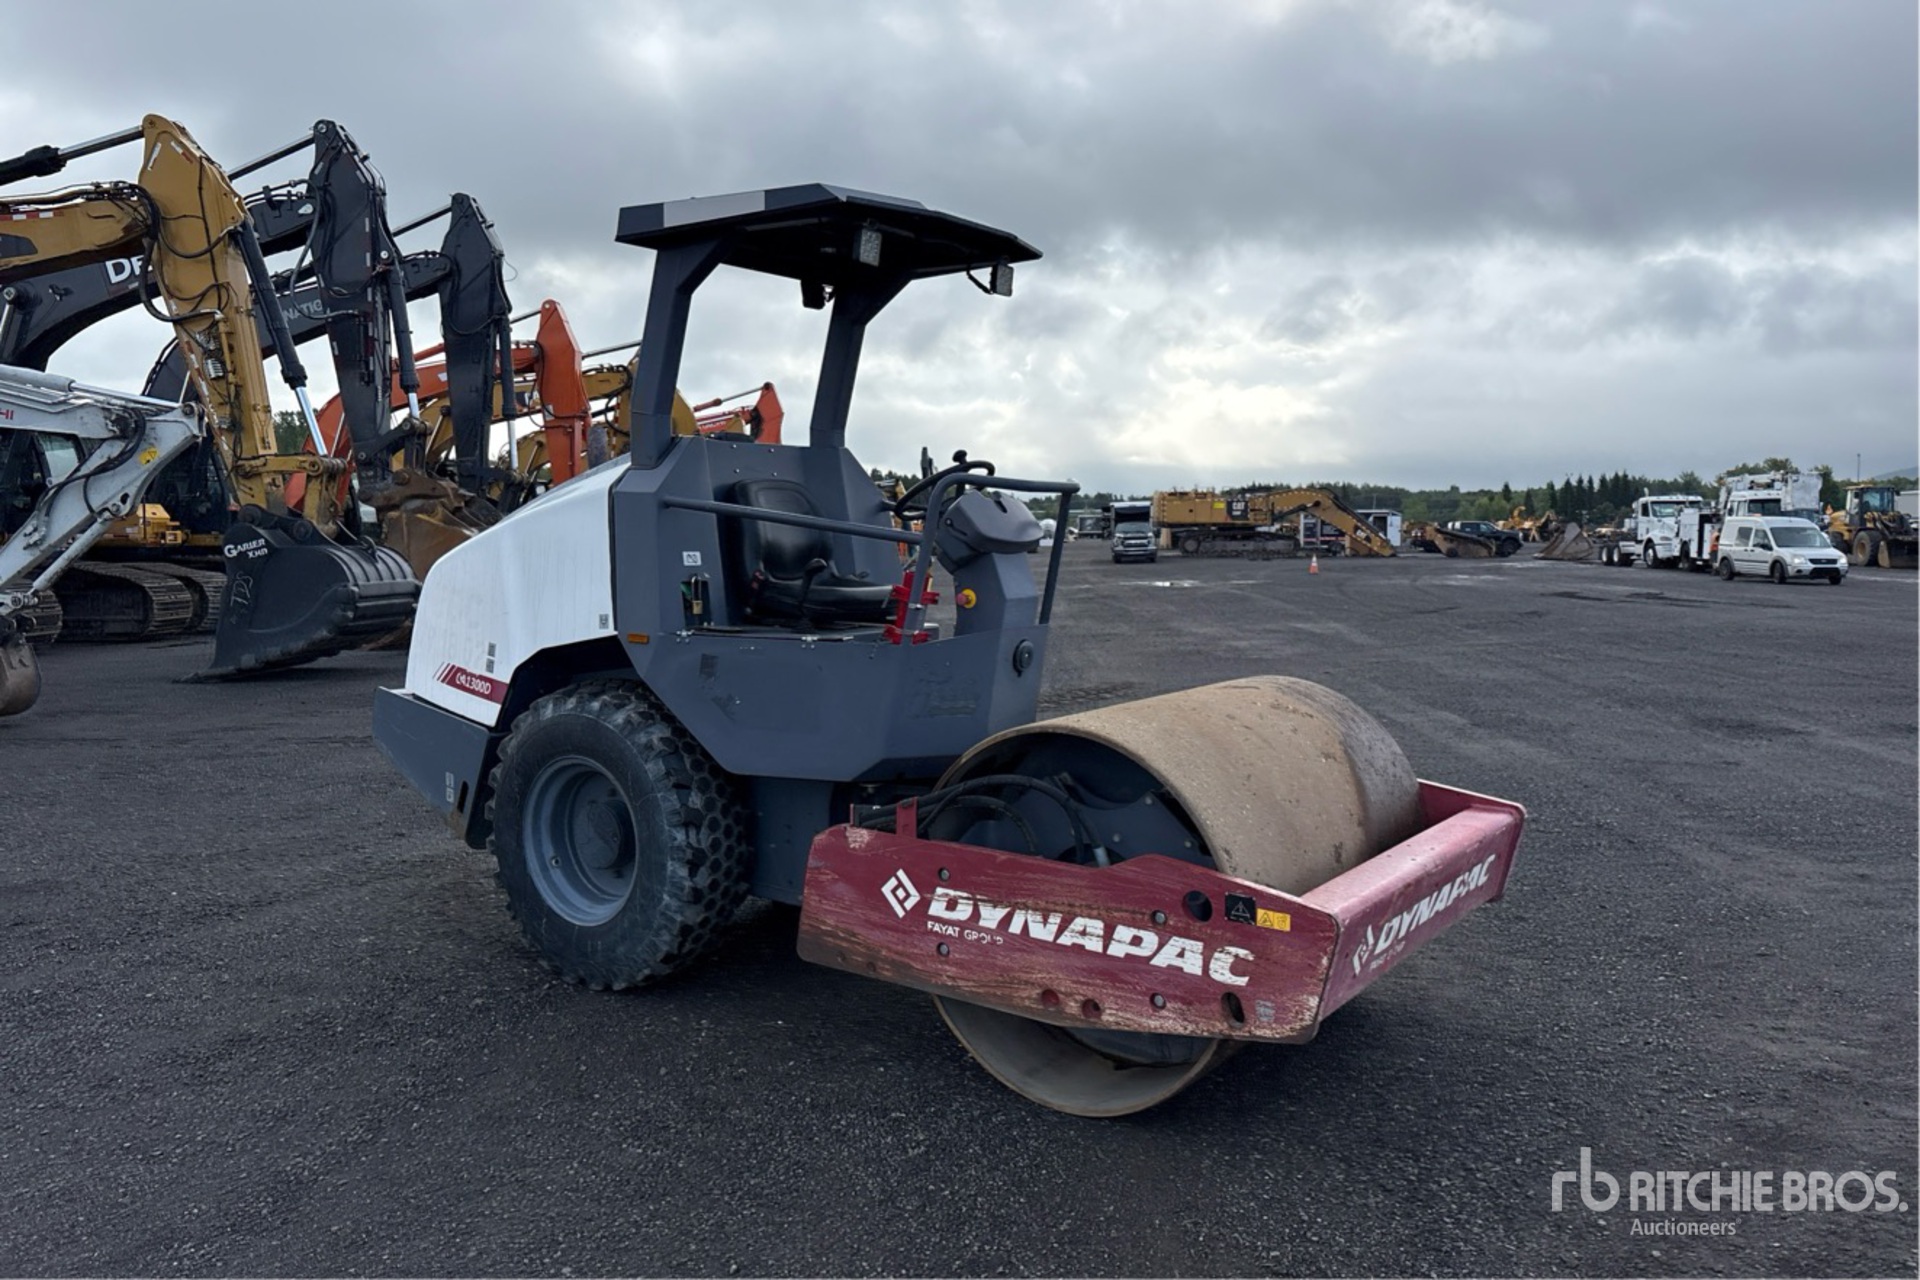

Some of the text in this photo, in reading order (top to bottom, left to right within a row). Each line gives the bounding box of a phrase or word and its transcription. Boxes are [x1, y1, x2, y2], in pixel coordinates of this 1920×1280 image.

[927, 920, 960, 938] FAYAT
[927, 886, 1255, 986] DYNAPAC
[1374, 853, 1496, 955] DYNAPAC
